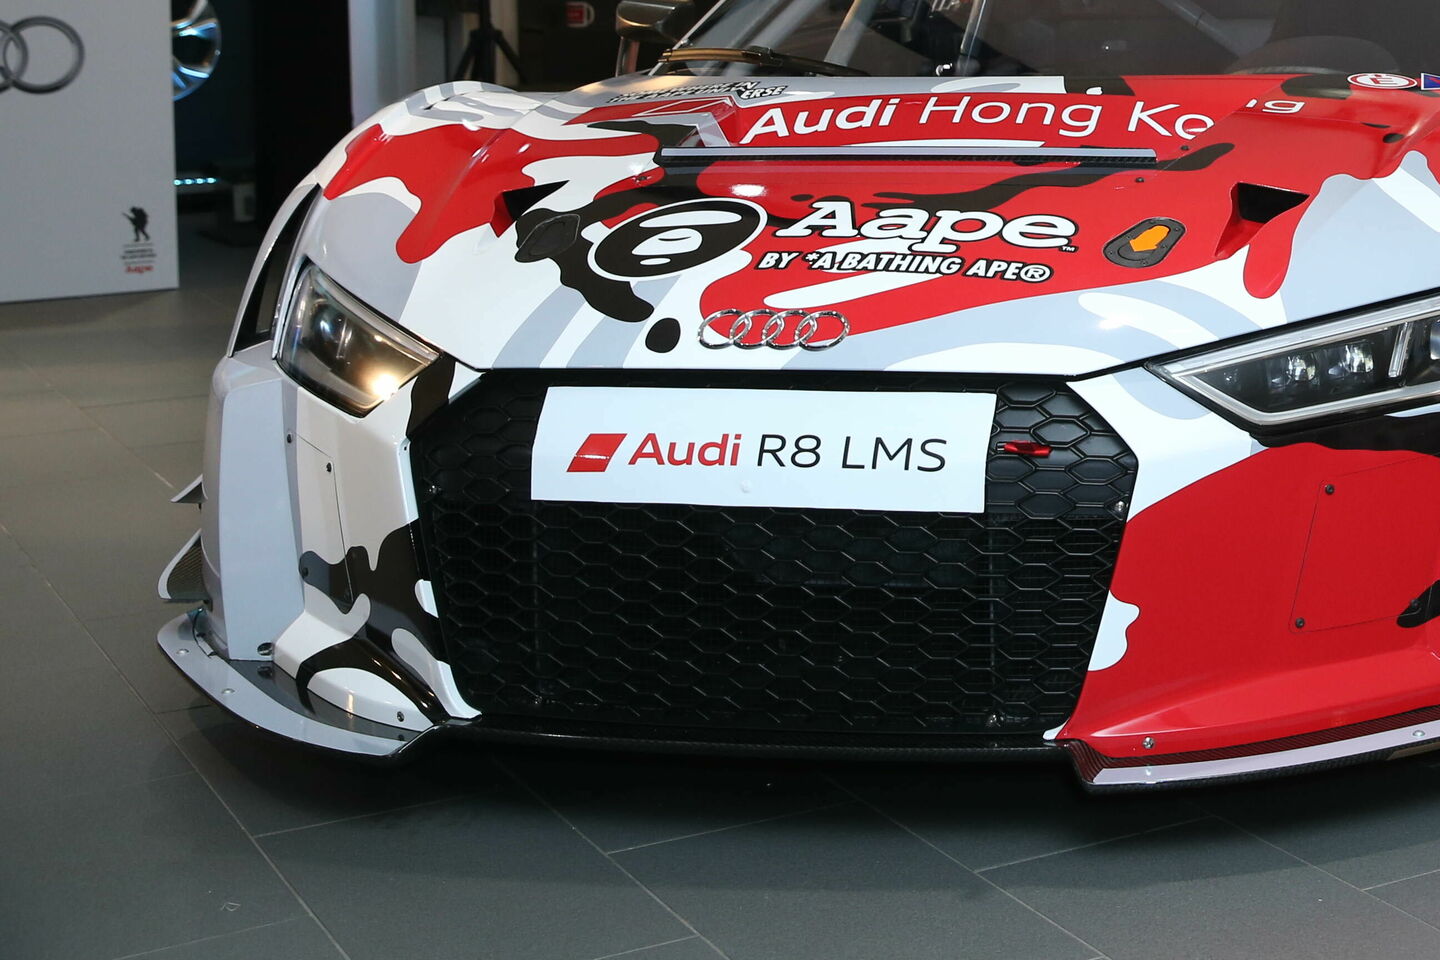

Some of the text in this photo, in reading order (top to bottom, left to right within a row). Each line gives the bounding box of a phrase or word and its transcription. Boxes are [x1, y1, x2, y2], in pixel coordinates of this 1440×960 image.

[738, 96, 1305, 145] Audi Hong Kog
[775, 200, 1077, 253] Aape
[758, 252, 799, 269] BY
[841, 253, 962, 275] BATHING
[628, 433, 948, 473] Audi R8 LMS
